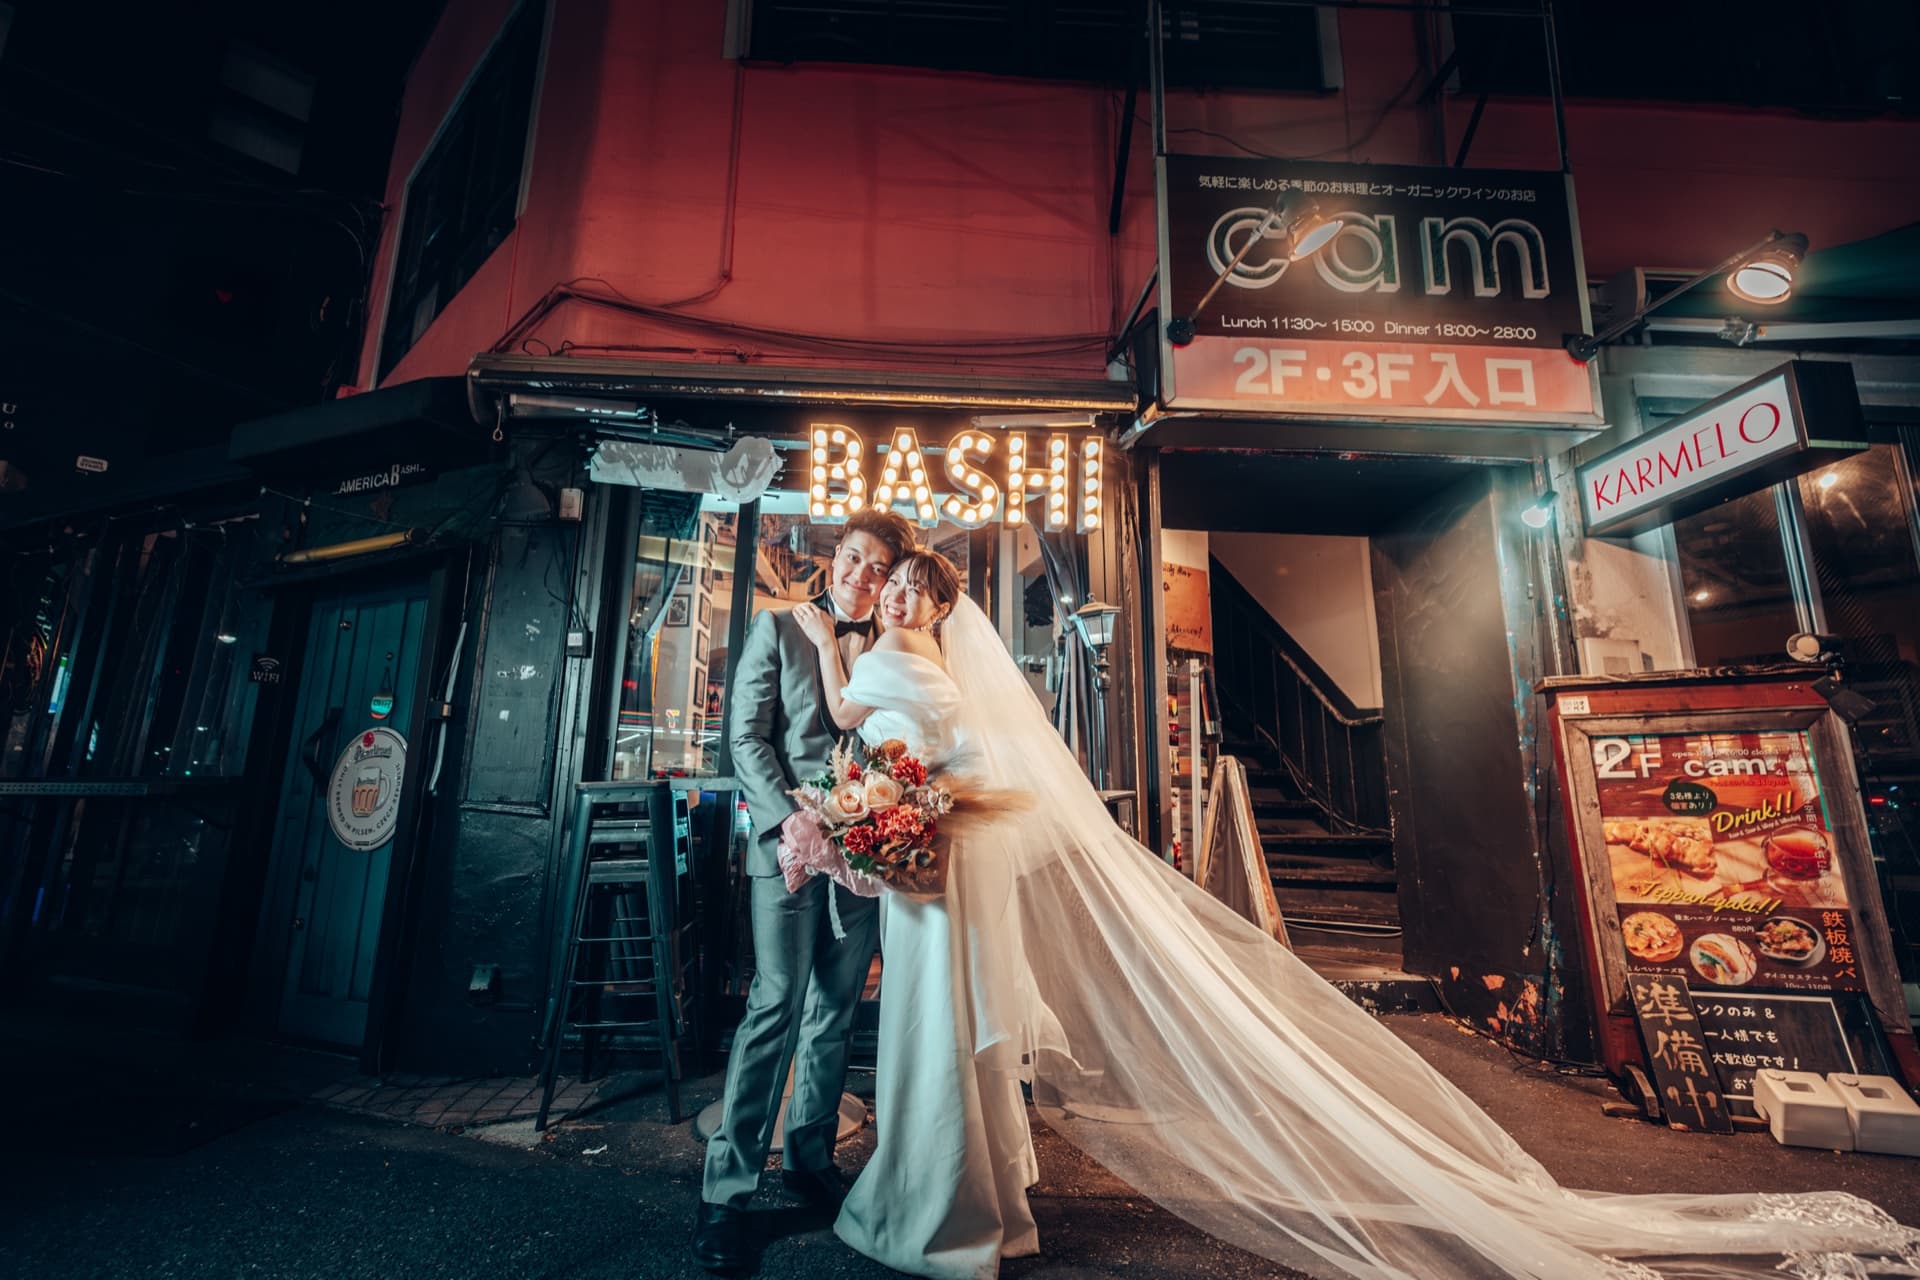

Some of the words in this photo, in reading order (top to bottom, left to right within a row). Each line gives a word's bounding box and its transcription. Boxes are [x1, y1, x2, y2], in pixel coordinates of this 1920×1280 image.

[1207, 206, 1551, 299] cam
[1221, 315, 1267, 329] Lunch
[1332, 319, 1374, 333] 15:00
[1384, 321, 1430, 336] Dinner
[1493, 326, 1537, 340] 28:00
[808, 423, 1104, 534] BASHI
[1593, 402, 1780, 511] KARMELO
[1593, 737, 1662, 779] 2F
[1711, 790, 1792, 833] Drink!!
[1639, 879, 1783, 916] Teppan-yaki!!
[1822, 911, 1862, 992] 鉄板焼バ
